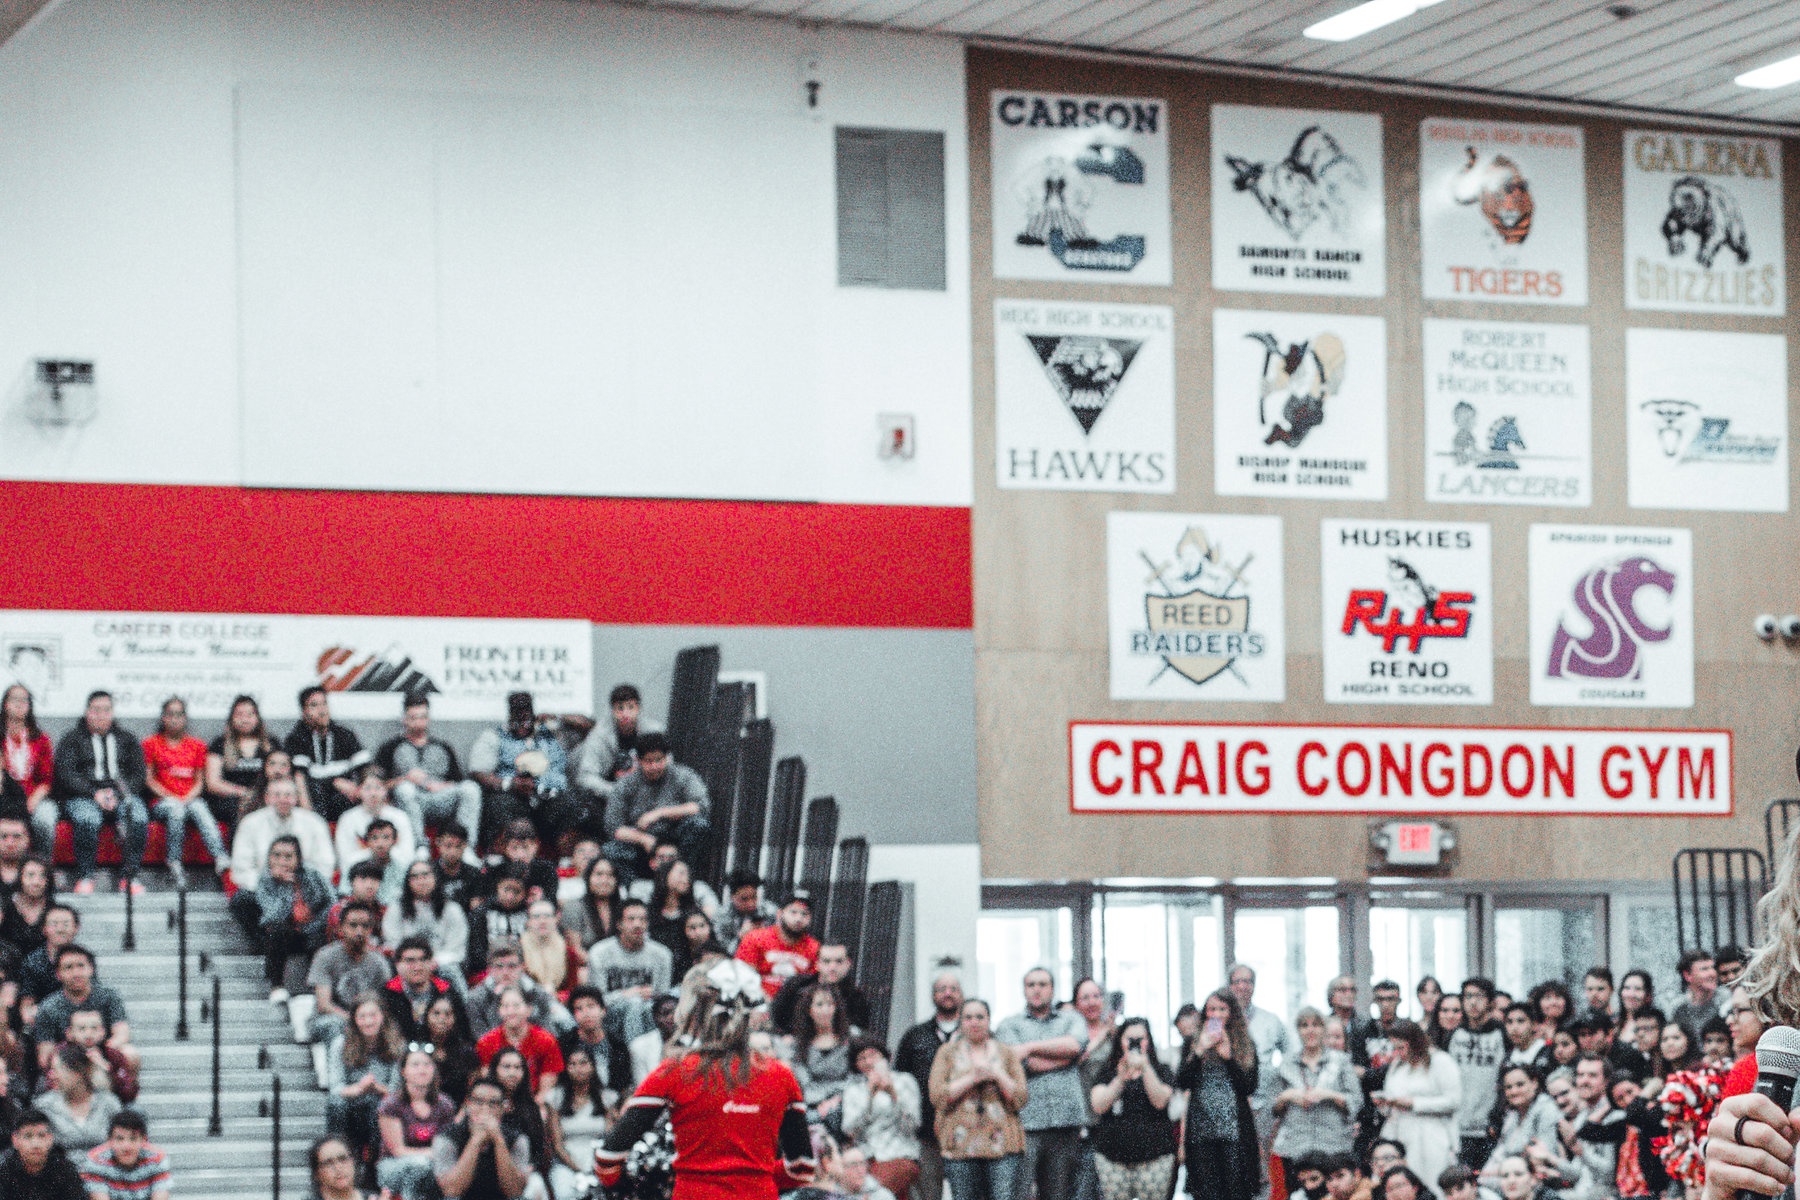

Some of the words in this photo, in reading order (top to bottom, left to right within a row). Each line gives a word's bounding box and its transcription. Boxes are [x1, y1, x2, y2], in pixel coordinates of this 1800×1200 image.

[998, 95, 1159, 134] CARSON
[1635, 136, 1772, 179] GALENA
[1449, 266, 1562, 298] TIGERS
[1637, 258, 1775, 308] GRIZZLIES
[1098, 311, 1167, 330] SCHOOL
[1461, 329, 1547, 348] ROBERT
[1008, 448, 1166, 484] HAWKS
[1437, 472, 1580, 499] LANCERS
[1341, 527, 1473, 549] HUSKIES
[1162, 604, 1233, 626] REED
[93, 621, 173, 639] CAREER
[178, 622, 270, 640] COLLEGE
[443, 645, 570, 663] FRONTIER
[1131, 632, 1267, 656] RAIDERS
[443, 668, 567, 685] FINANCIAL
[1370, 661, 1450, 679] RENO
[1342, 682, 1389, 695] HIGH
[1396, 683, 1475, 697] SCHOOL
[1088, 739, 1272, 797] CRAIG
[1295, 741, 1575, 799] CONGDON
[1599, 745, 1716, 801] GYM
